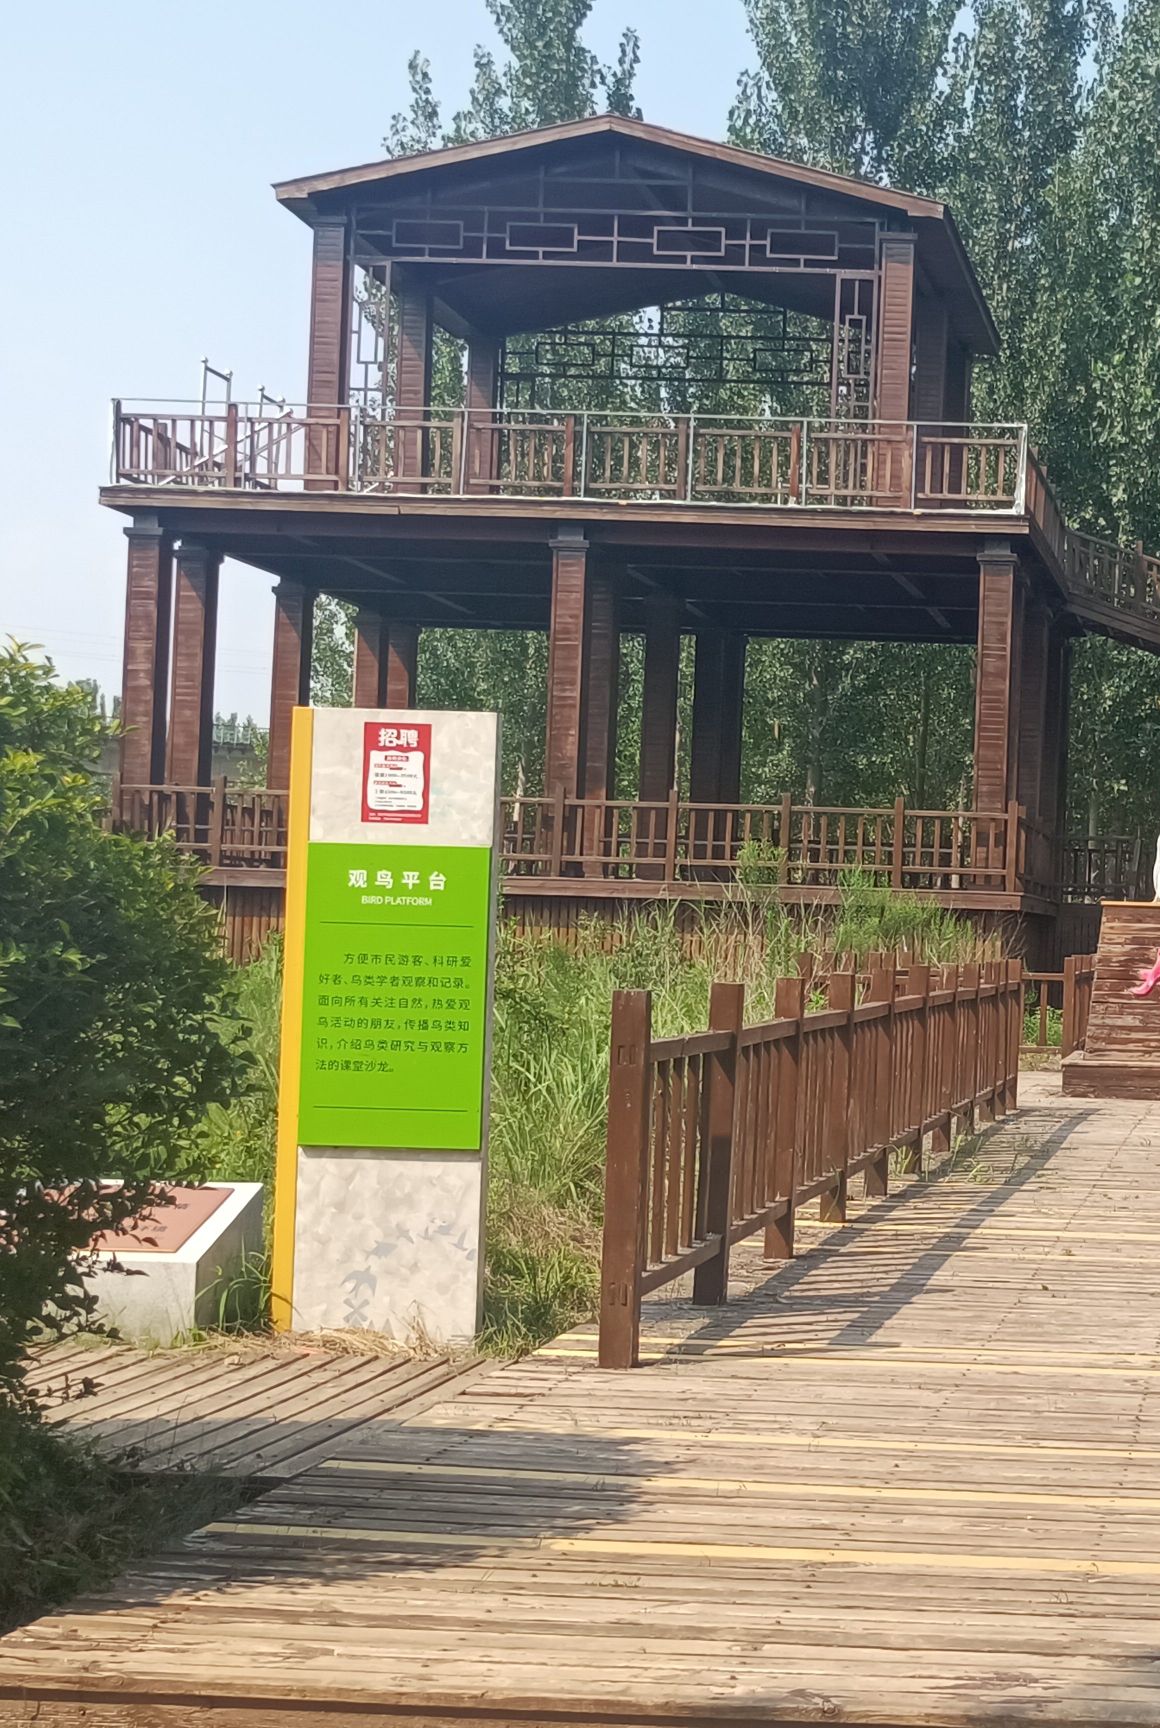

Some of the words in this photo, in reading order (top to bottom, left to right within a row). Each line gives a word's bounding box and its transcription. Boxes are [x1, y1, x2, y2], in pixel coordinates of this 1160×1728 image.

[378, 728, 419, 748] 招聘
[348, 869, 447, 891] 观鸟平台
[361, 895, 383, 905] BIRD
[384, 896, 432, 906] PLATFORM
[343, 953, 472, 968] 方便市民游客、科研爱
